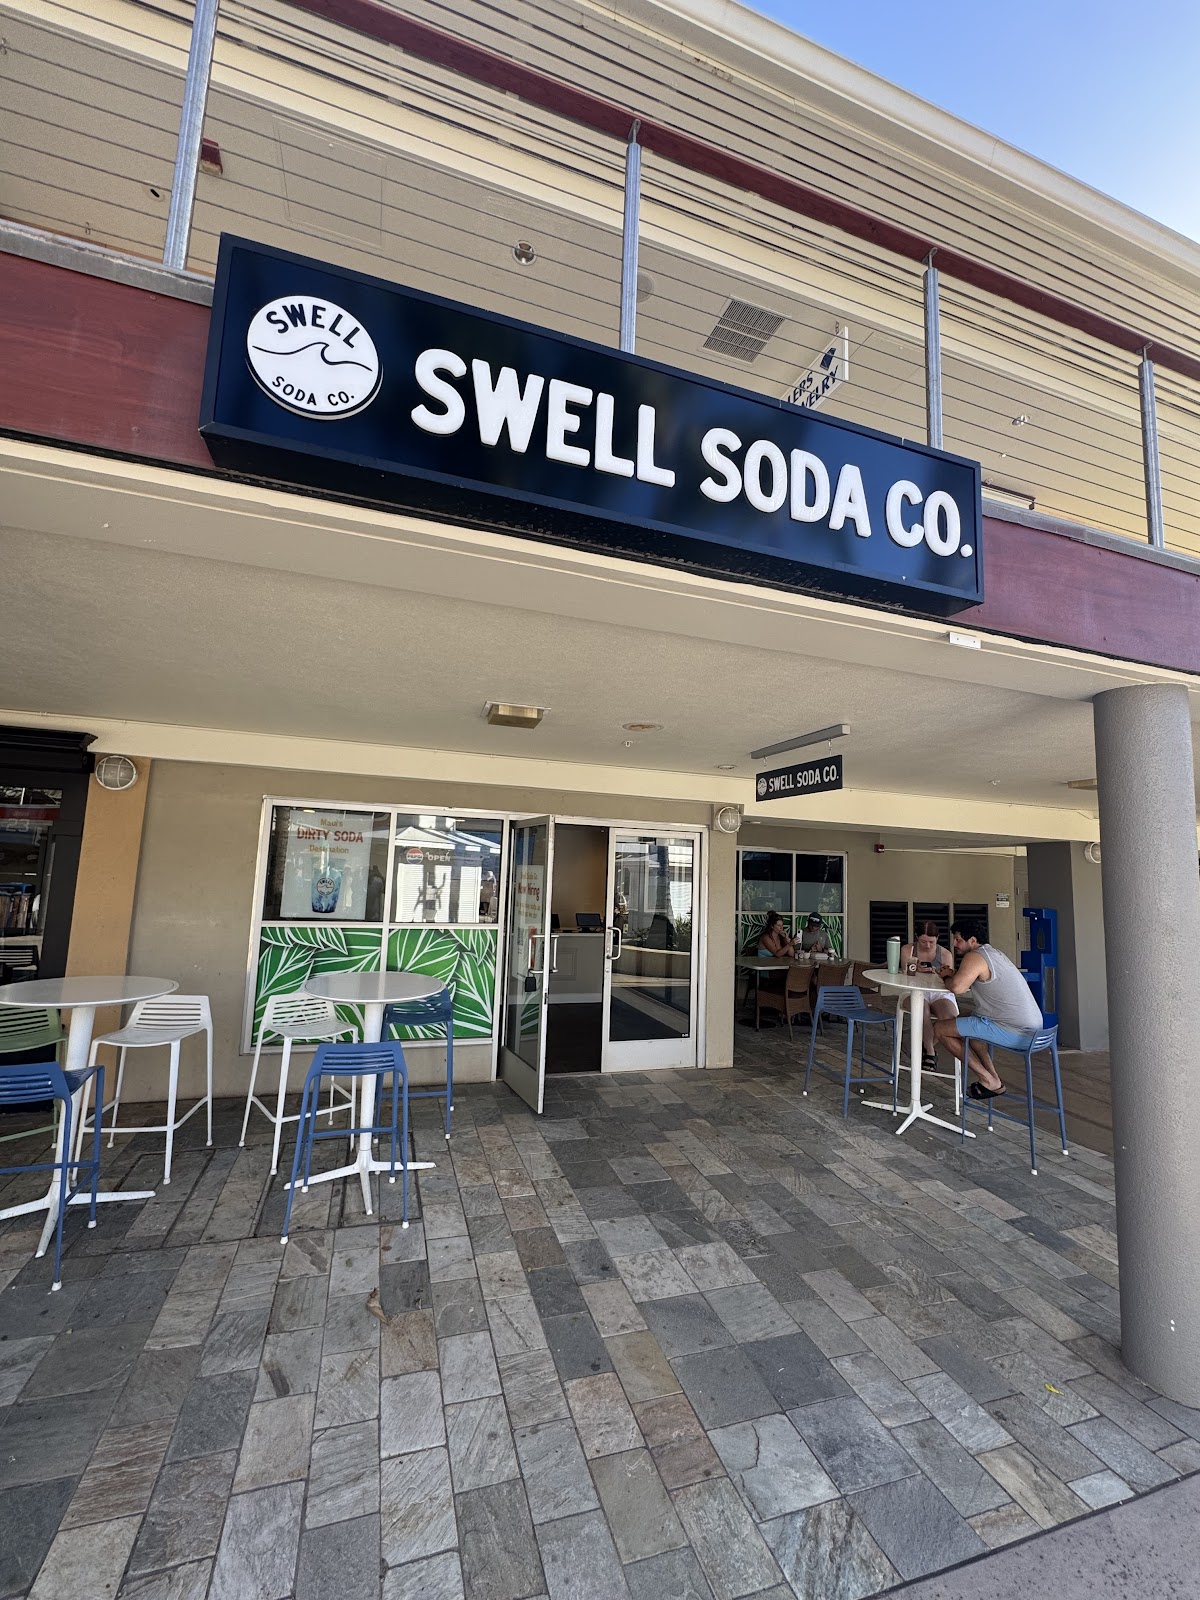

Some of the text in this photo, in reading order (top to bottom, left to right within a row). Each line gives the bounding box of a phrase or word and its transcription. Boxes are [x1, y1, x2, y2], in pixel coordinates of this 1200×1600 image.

[266, 303, 361, 349] SWELL
[272, 376, 354, 406] SODA CO.
[411, 348, 973, 558] SWELL SODA CO.
[769, 774, 795, 792] SWELL
[797, 768, 821, 787] SODA
[823, 765, 840, 783] CO.
[297, 827, 364, 843] DIRTY SODA
[427, 854, 451, 862] OPEN
